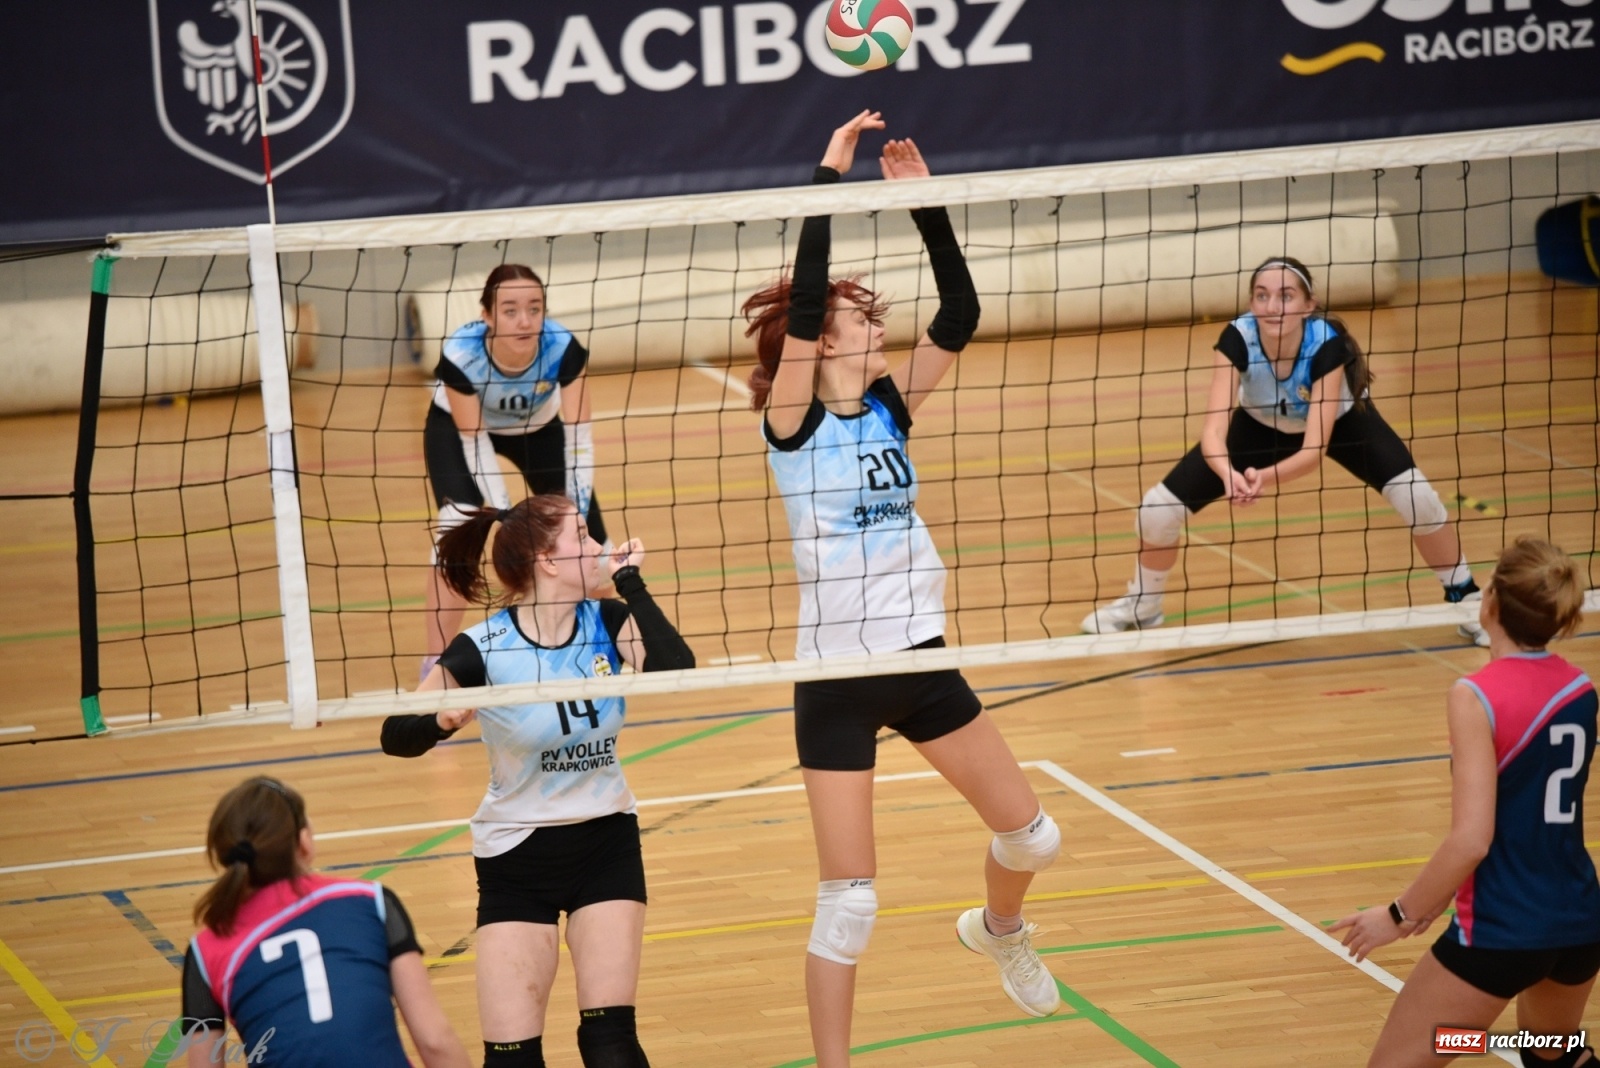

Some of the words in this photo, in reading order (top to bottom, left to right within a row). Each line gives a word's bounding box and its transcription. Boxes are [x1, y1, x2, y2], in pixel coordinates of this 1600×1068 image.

[1404, 14, 1594, 63] RACIBÓRZ
[858, 448, 912, 490] 20
[555, 699, 599, 736] 14
[541, 748, 561, 761] PV
[565, 735, 617, 760] VOLLEY
[1543, 723, 1586, 824] 2
[259, 928, 333, 1024] 7
